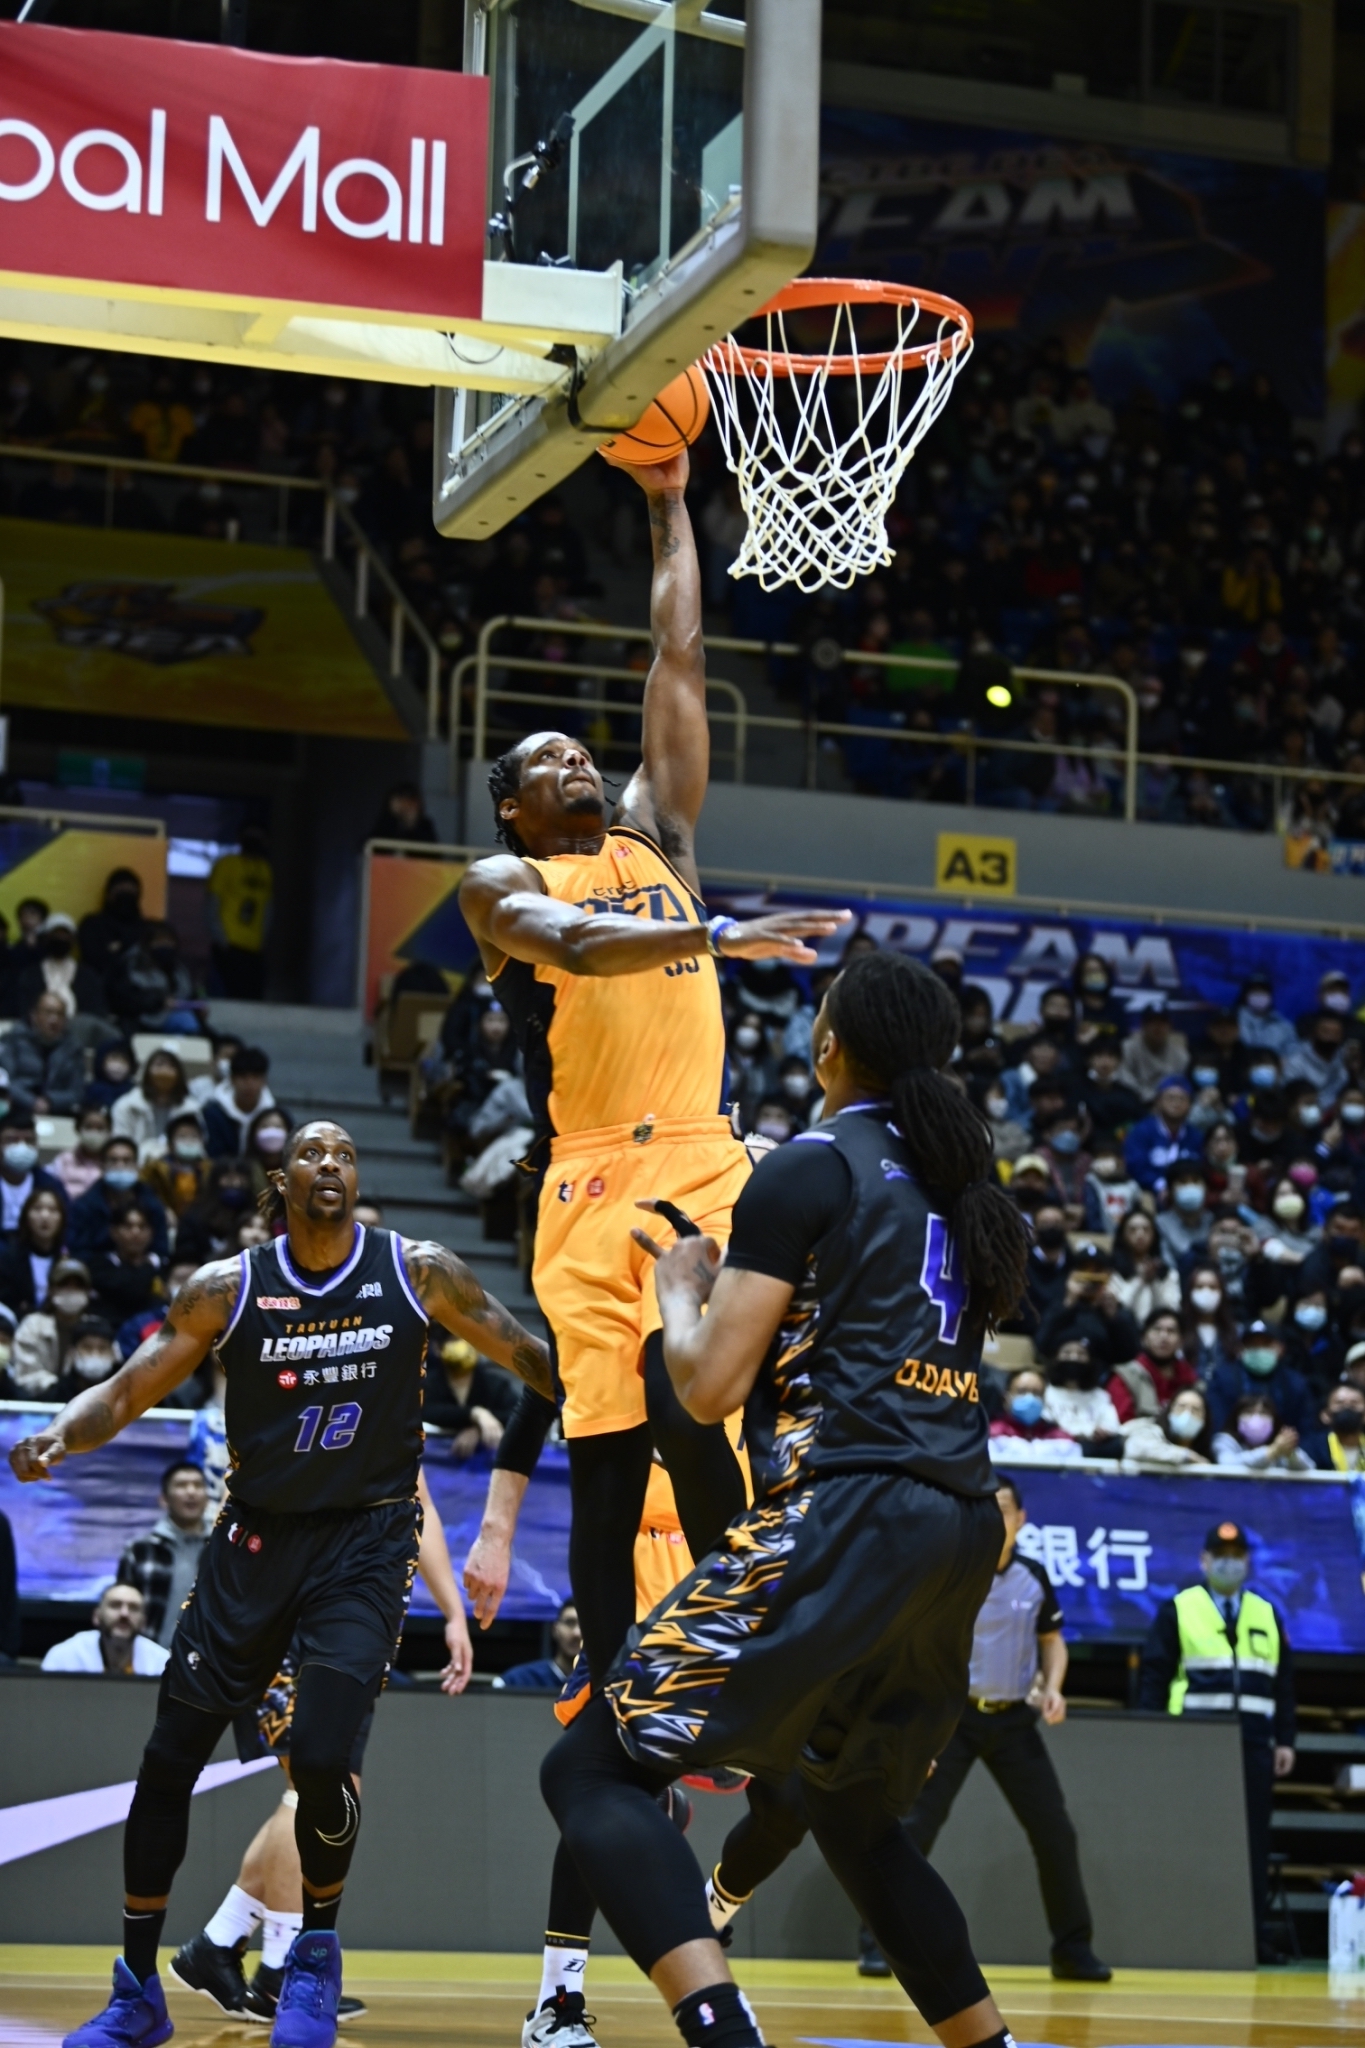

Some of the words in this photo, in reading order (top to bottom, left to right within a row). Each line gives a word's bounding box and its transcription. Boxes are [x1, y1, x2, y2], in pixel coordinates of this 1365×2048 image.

[206, 115, 446, 246] Mall
[943, 848, 1008, 887] A3
[919, 1212, 970, 1345] 4
[260, 1324, 393, 1362] LEOPARDS
[286, 1316, 362, 1334] TAOYUAN
[303, 1362, 377, 1386] 永豐銀行
[294, 1401, 363, 1452] 12
[1015, 1522, 1153, 1591] 銀行
